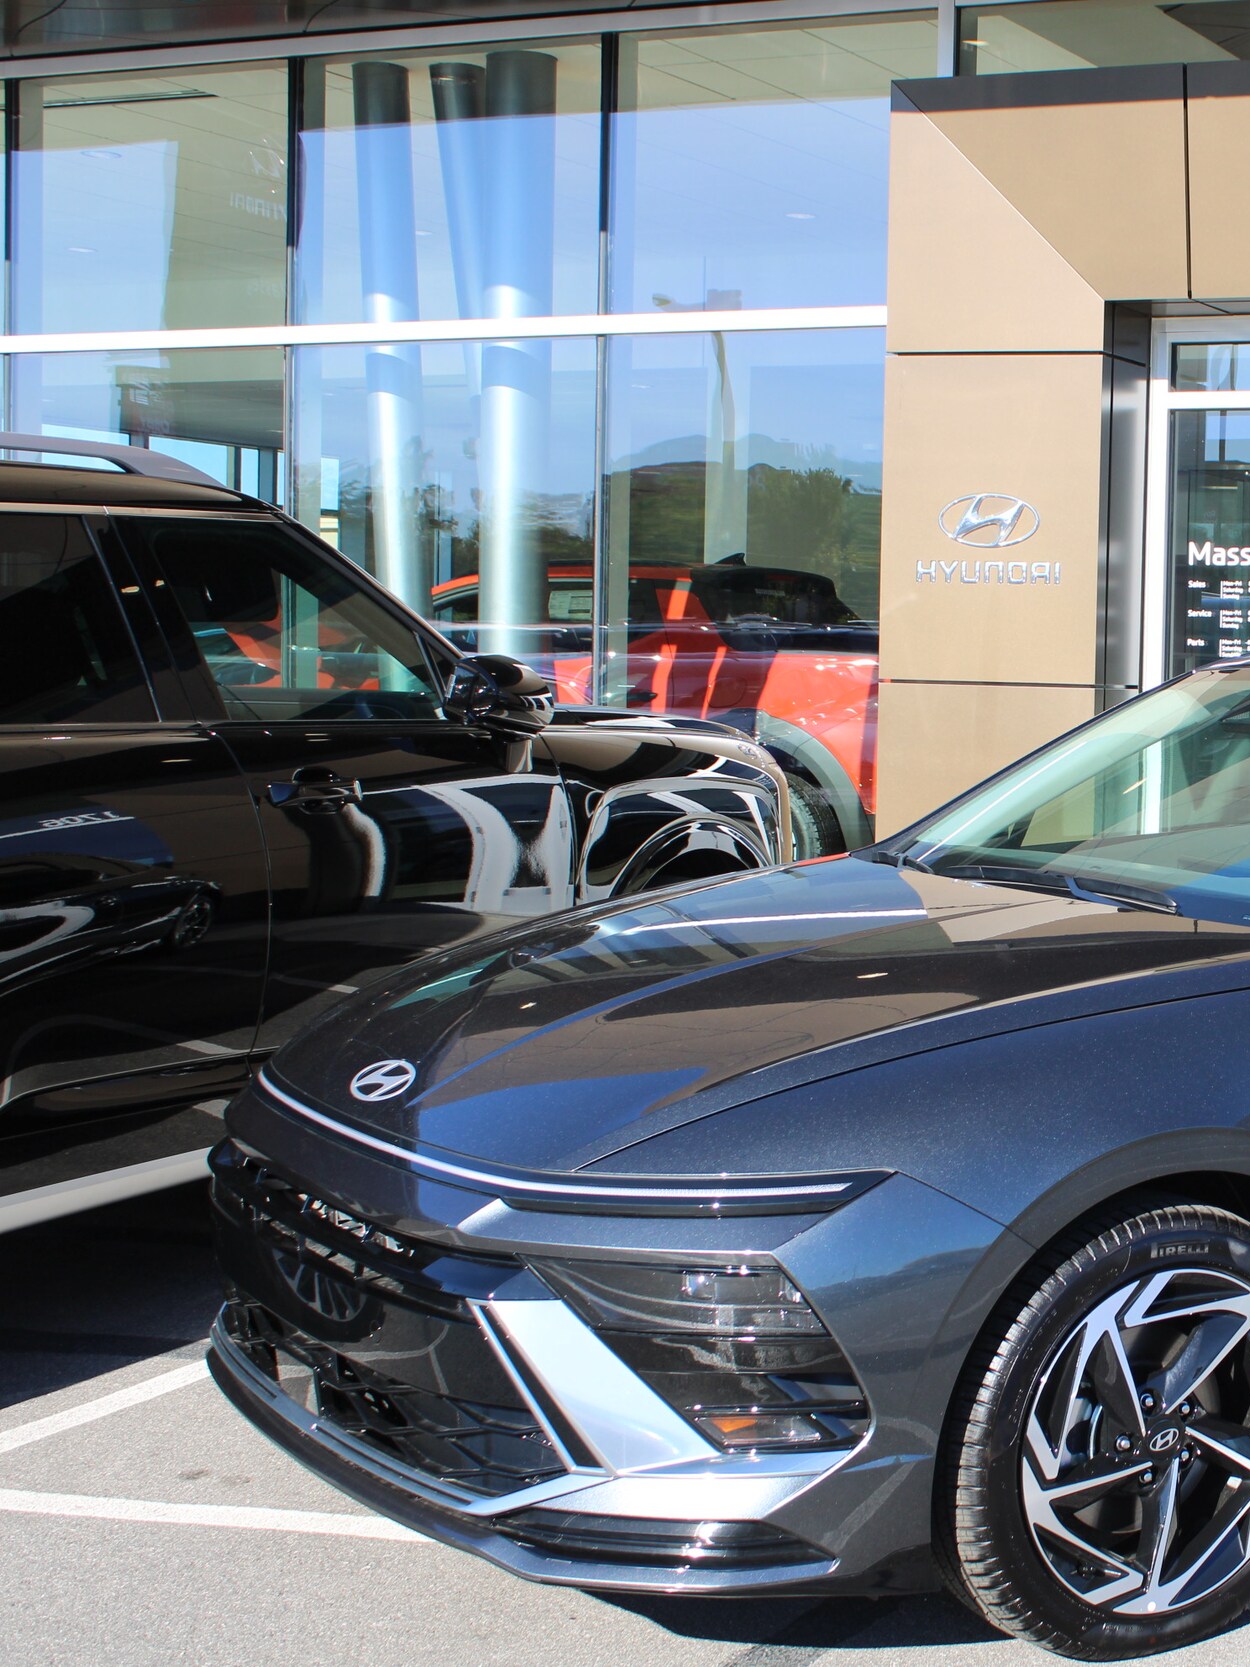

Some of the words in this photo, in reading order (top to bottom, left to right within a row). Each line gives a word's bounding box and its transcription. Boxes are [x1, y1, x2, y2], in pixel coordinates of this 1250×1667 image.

[915, 559, 1062, 585] HYUNDAI
[1187, 580, 1207, 589] Sales
[1187, 609, 1213, 618] Service
[1186, 638, 1206, 647] Parts
[1150, 1239, 1211, 1259] PIRELLI
